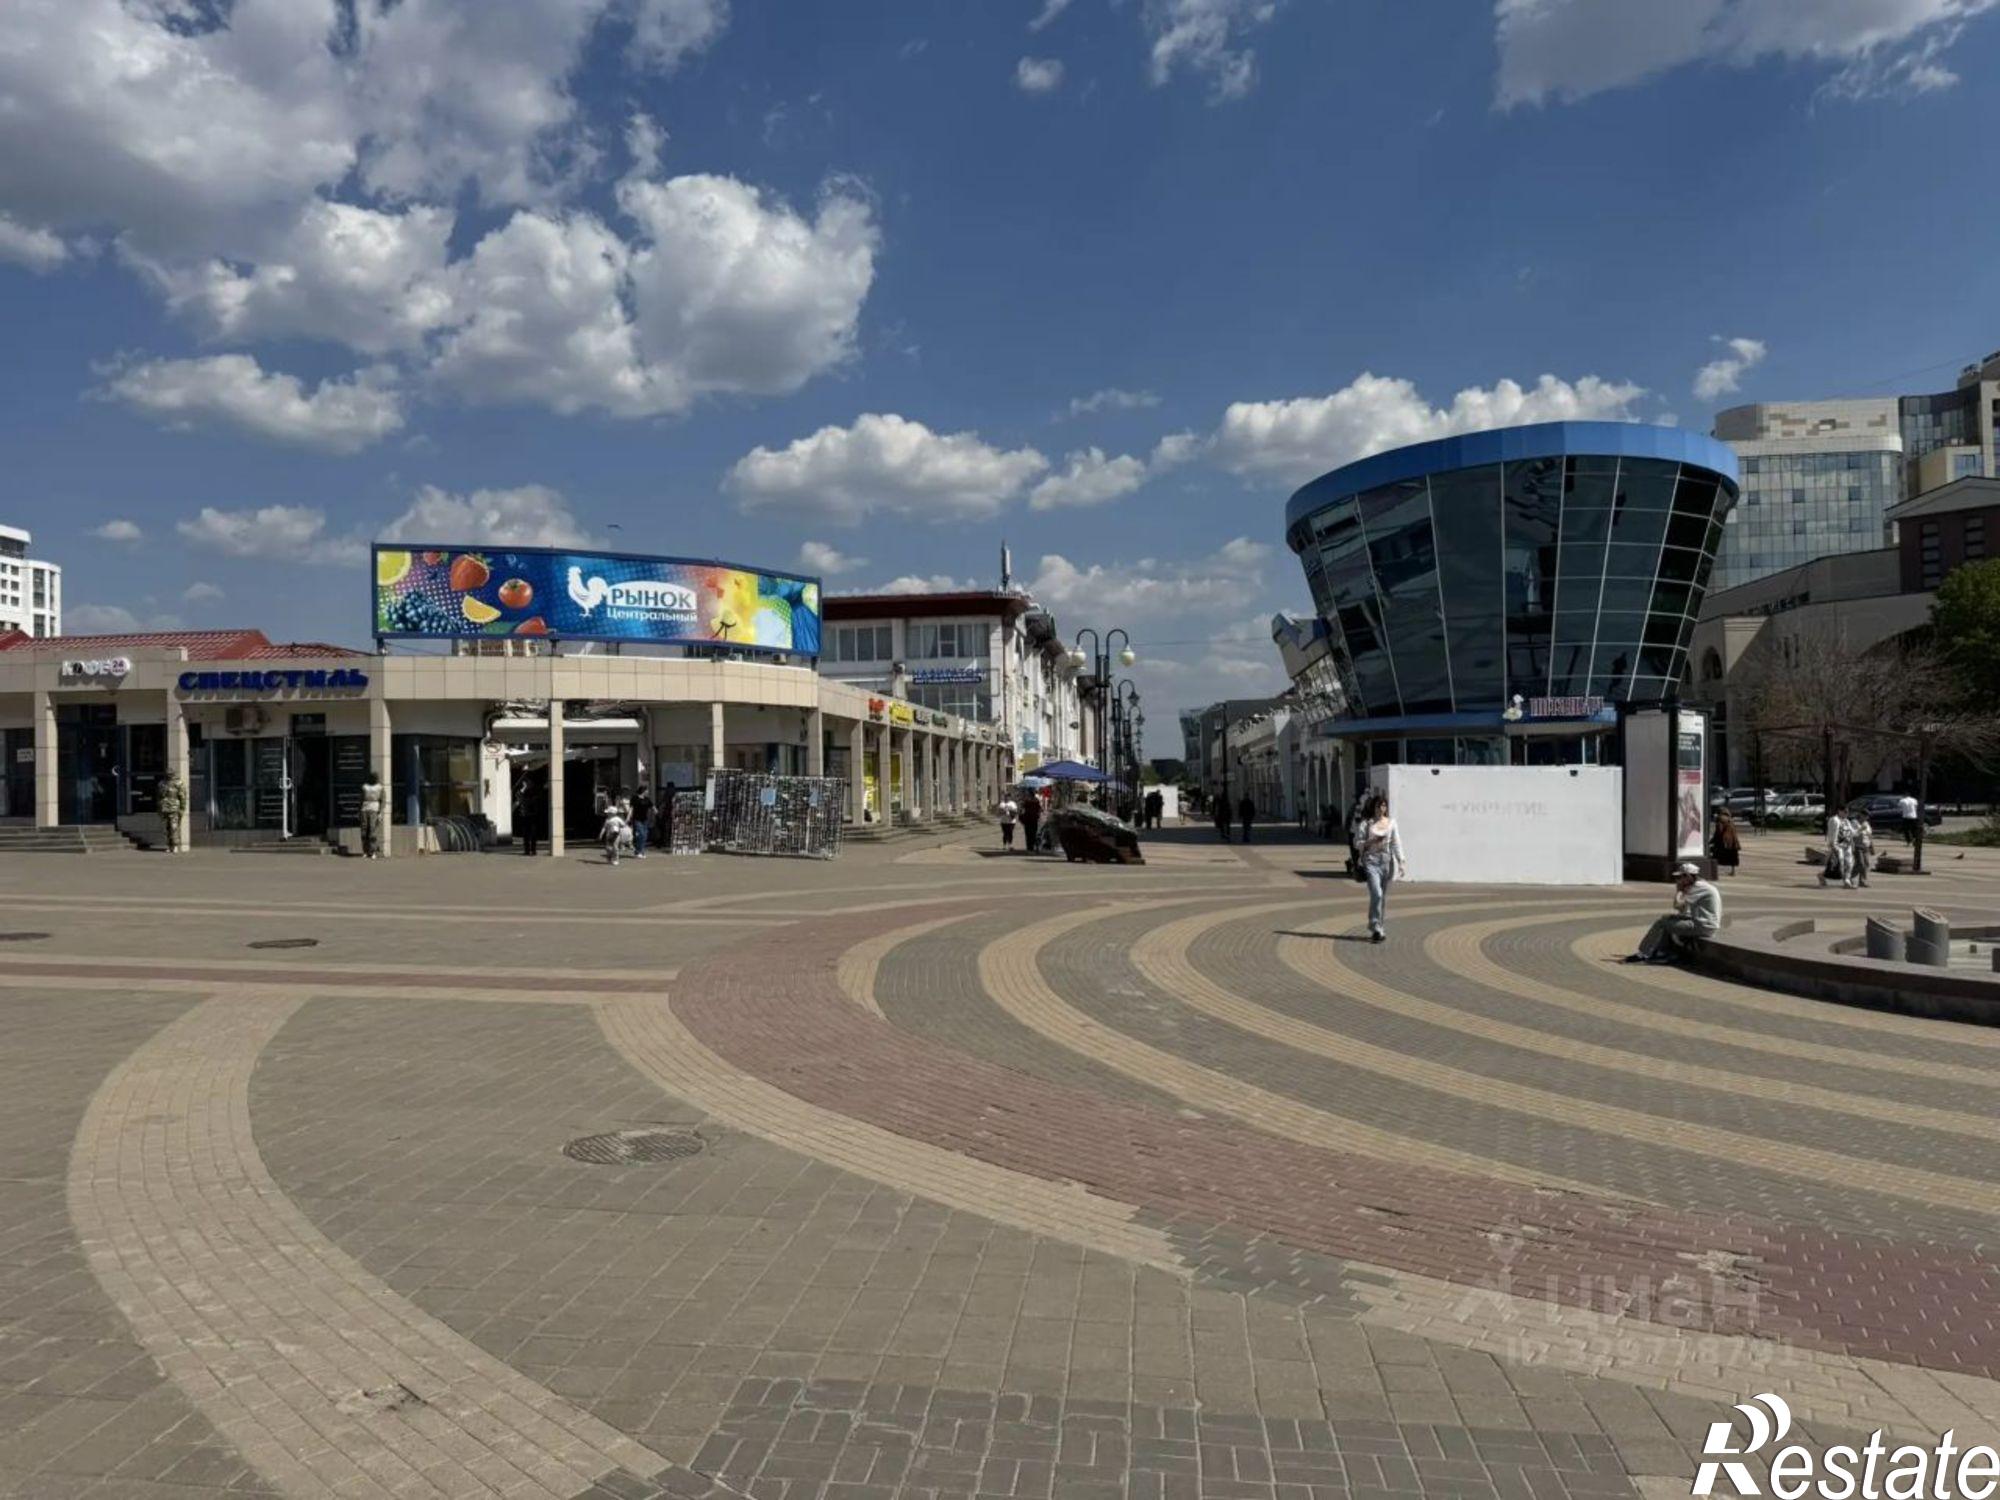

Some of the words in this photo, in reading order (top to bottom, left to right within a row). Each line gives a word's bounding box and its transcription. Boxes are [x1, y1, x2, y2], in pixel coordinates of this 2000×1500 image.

[611, 588, 692, 608] РЫНОК
[606, 606, 698, 622] Центральный
[178, 669, 369, 691] СПЕЦСТИЛЬ
